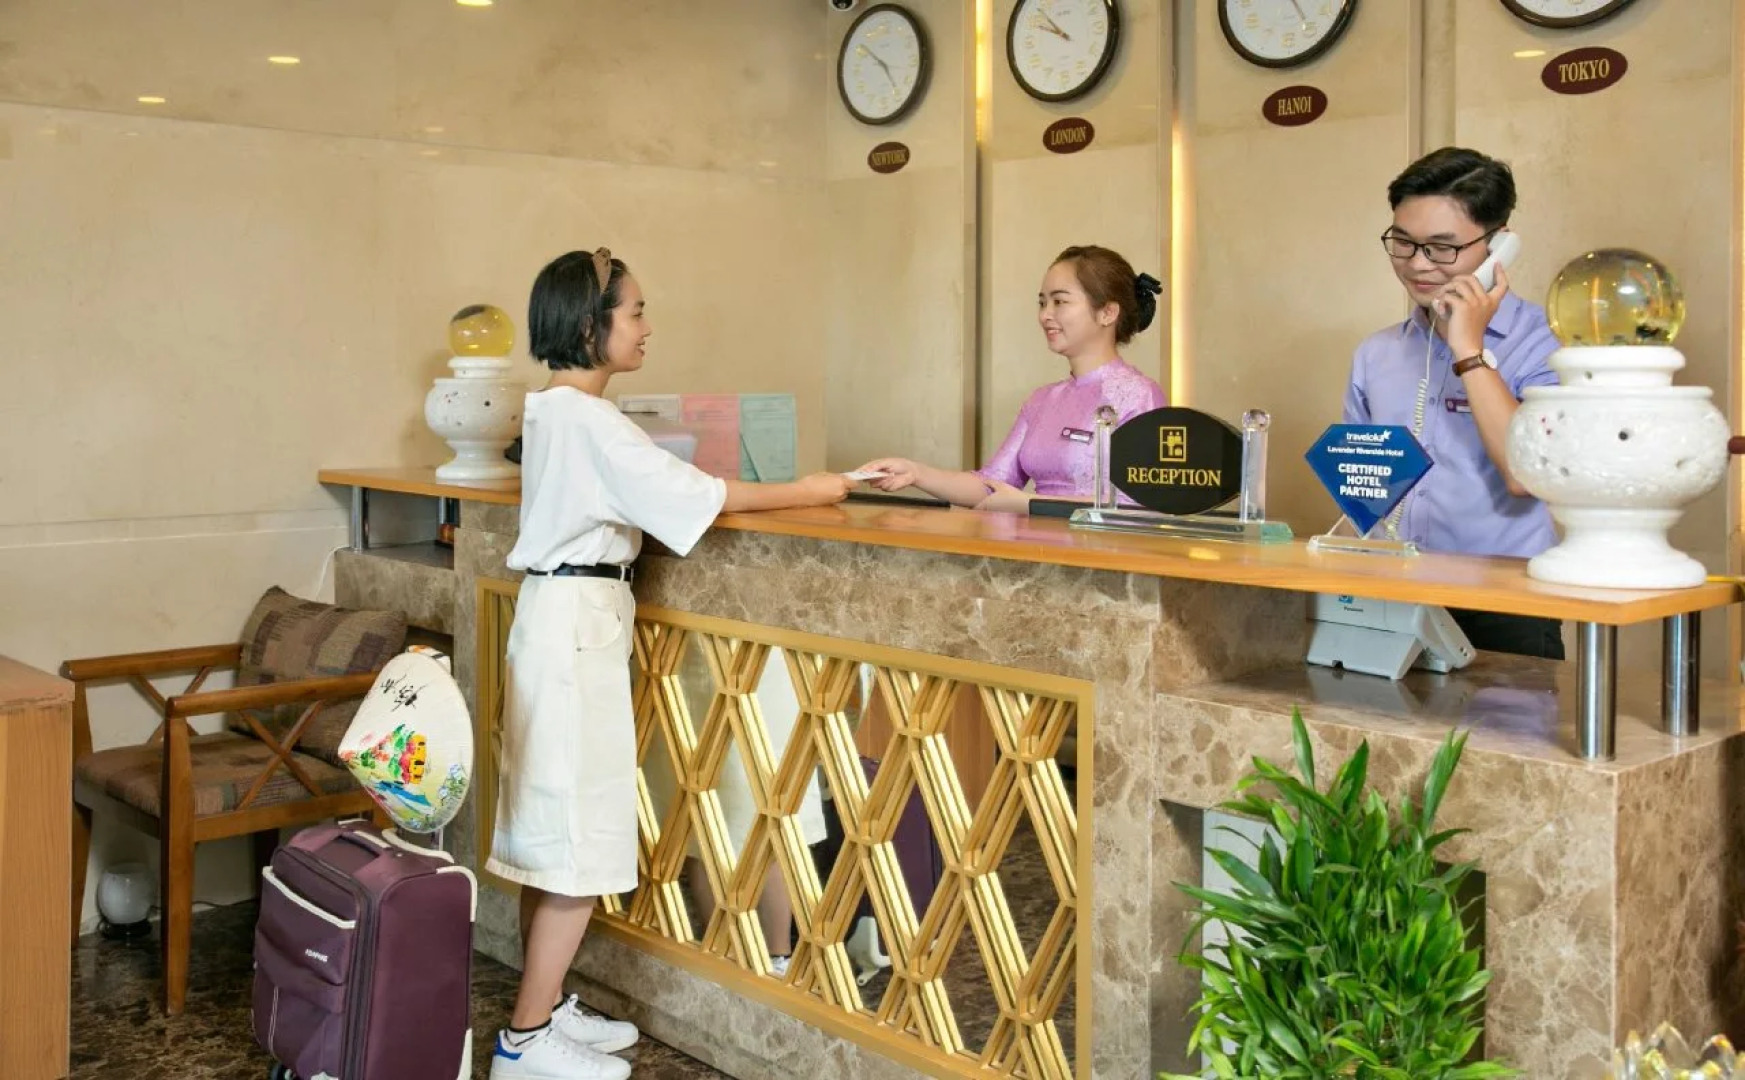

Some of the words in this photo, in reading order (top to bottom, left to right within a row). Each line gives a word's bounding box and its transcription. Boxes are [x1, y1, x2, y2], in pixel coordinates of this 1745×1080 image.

[1558, 58, 1610, 83] TOKYO
[1278, 96, 1313, 116] HANOI
[1050, 126, 1087, 146] LONDON
[1327, 445, 1357, 454] Lavender
[1356, 447, 1385, 456] Riverside
[1385, 449, 1404, 457] Hotel
[1126, 466, 1222, 487] RECEPTION
[1338, 463, 1392, 476] CERTIFIED
[1346, 475, 1382, 487] HOTEL
[1340, 485, 1389, 499] PARTNER
